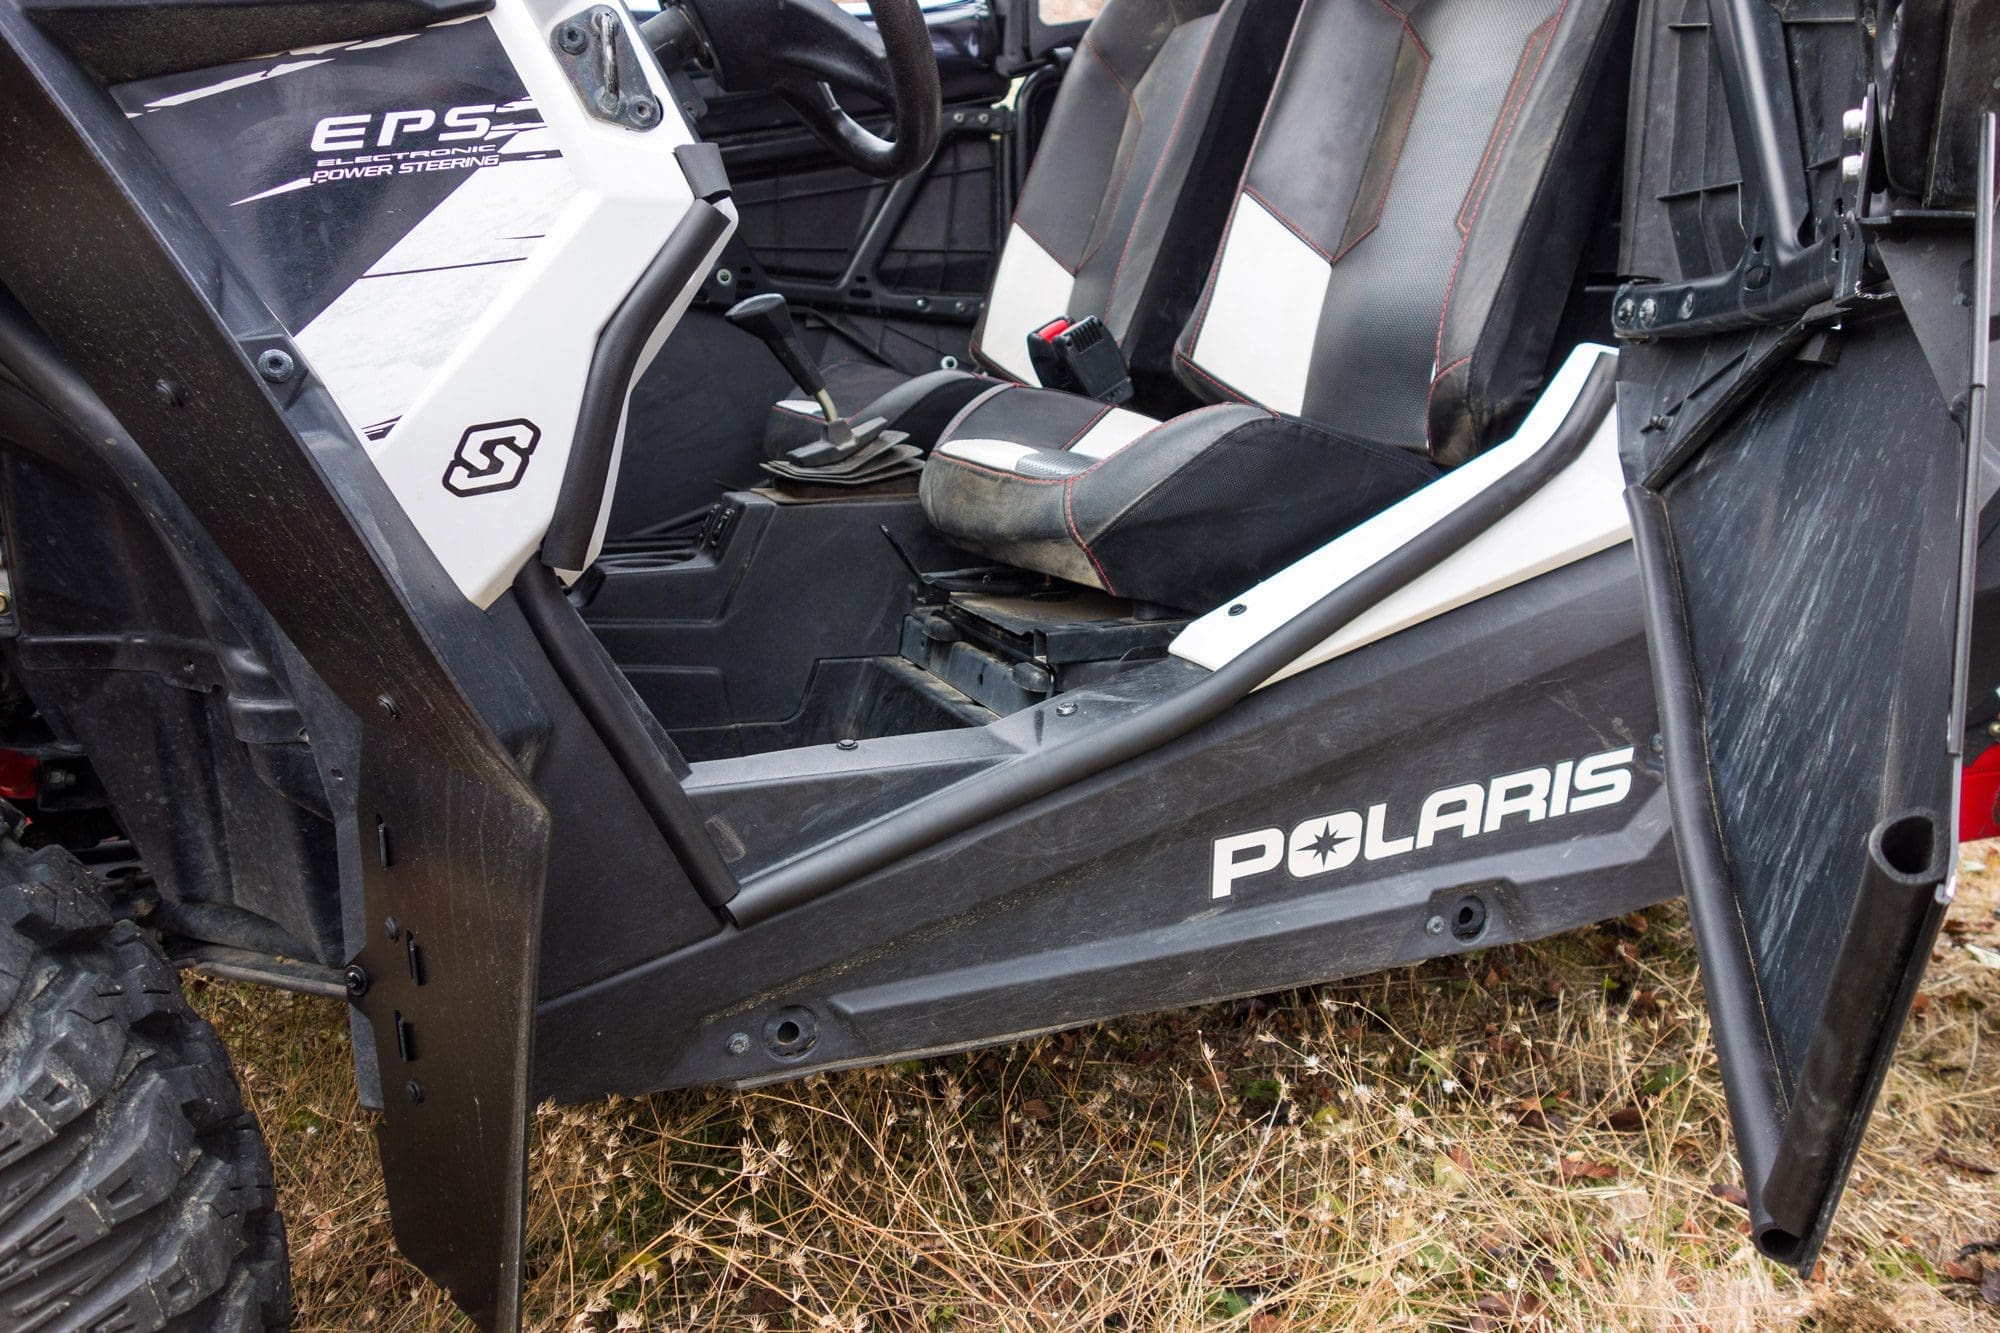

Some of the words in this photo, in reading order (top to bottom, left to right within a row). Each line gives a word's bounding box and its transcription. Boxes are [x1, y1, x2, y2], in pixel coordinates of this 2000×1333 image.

[311, 104, 496, 152] EPS
[311, 164, 393, 184] POWER
[399, 155, 500, 174] STEERING
[316, 144, 496, 167] ELECTRONIC
[1212, 747, 1635, 899] POLARIS
